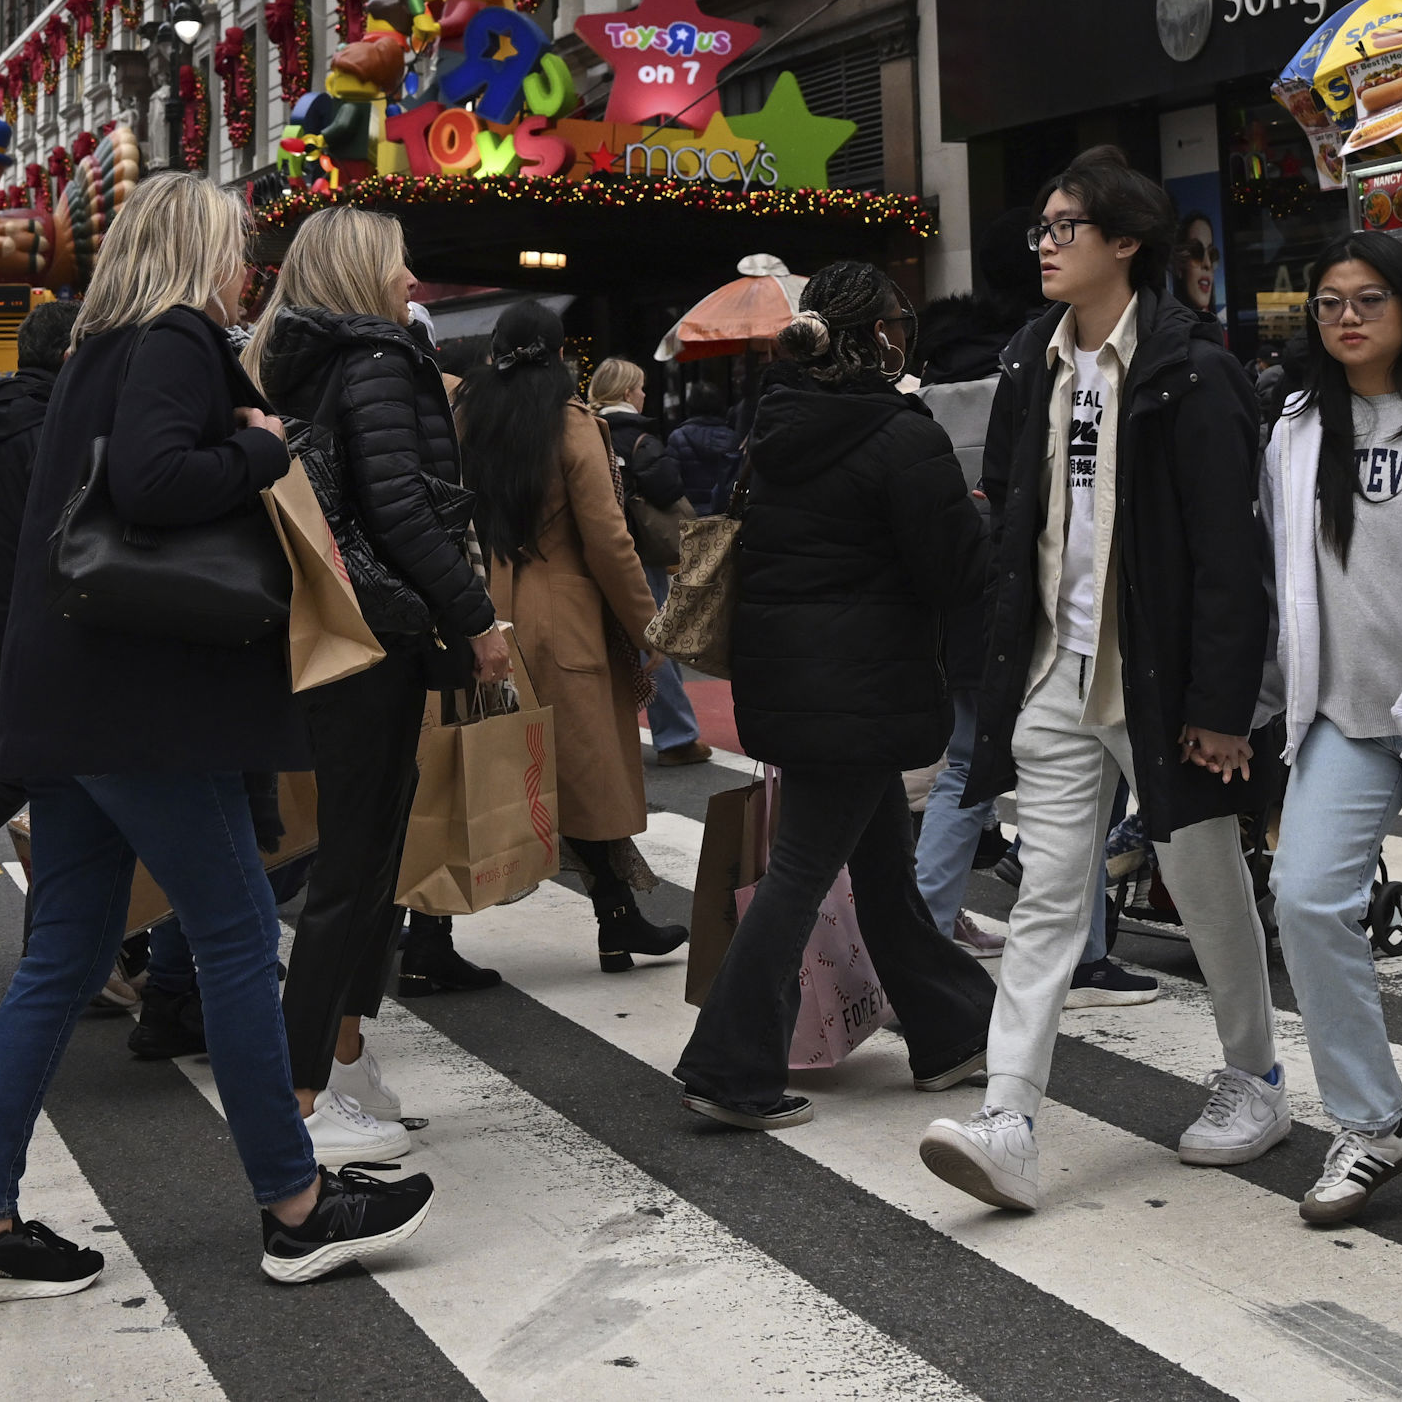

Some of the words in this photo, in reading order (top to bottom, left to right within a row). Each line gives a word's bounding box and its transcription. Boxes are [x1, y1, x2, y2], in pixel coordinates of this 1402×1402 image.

[638, 64, 675, 85] on
[682, 60, 702, 85] 7
[1360, 59, 1380, 70] Best
[1373, 173, 1401, 188] NANCY
[1072, 390, 1103, 409] EAL
[842, 984, 888, 1035] FOREV
